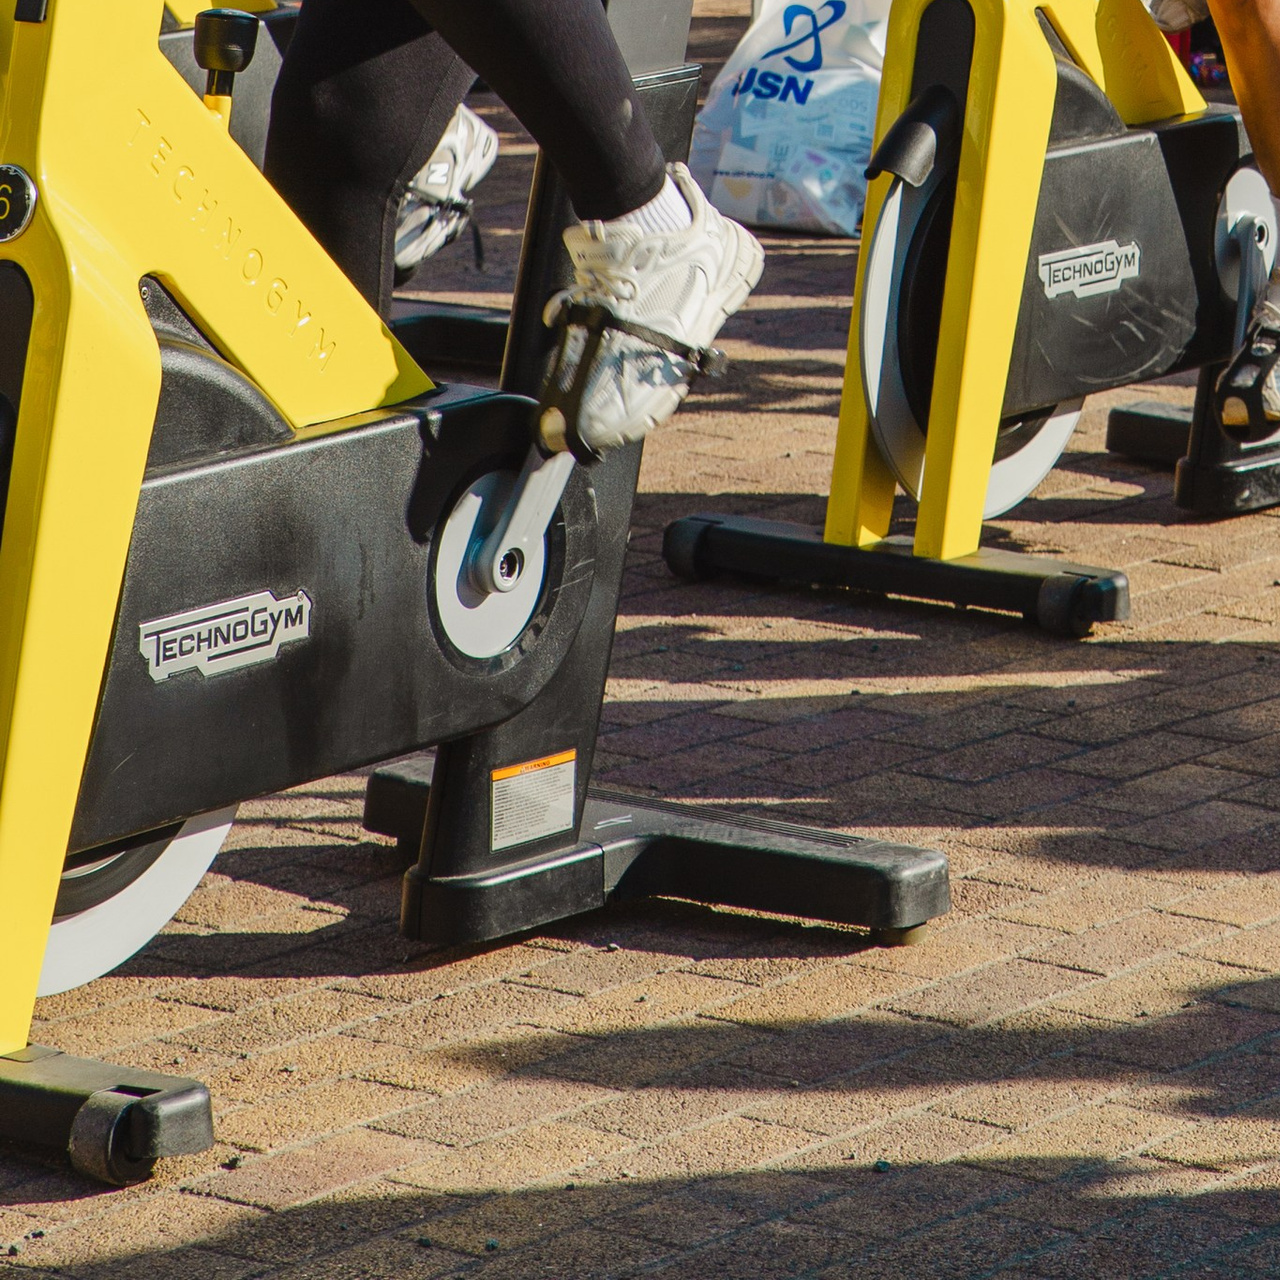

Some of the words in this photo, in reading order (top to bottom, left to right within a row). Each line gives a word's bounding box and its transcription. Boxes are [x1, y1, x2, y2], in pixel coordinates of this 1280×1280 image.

[127, 107, 337, 373] TECHNOGYM
[1042, 251, 1136, 288] TECHNOGYM
[144, 604, 304, 668] TECHNOGYM
